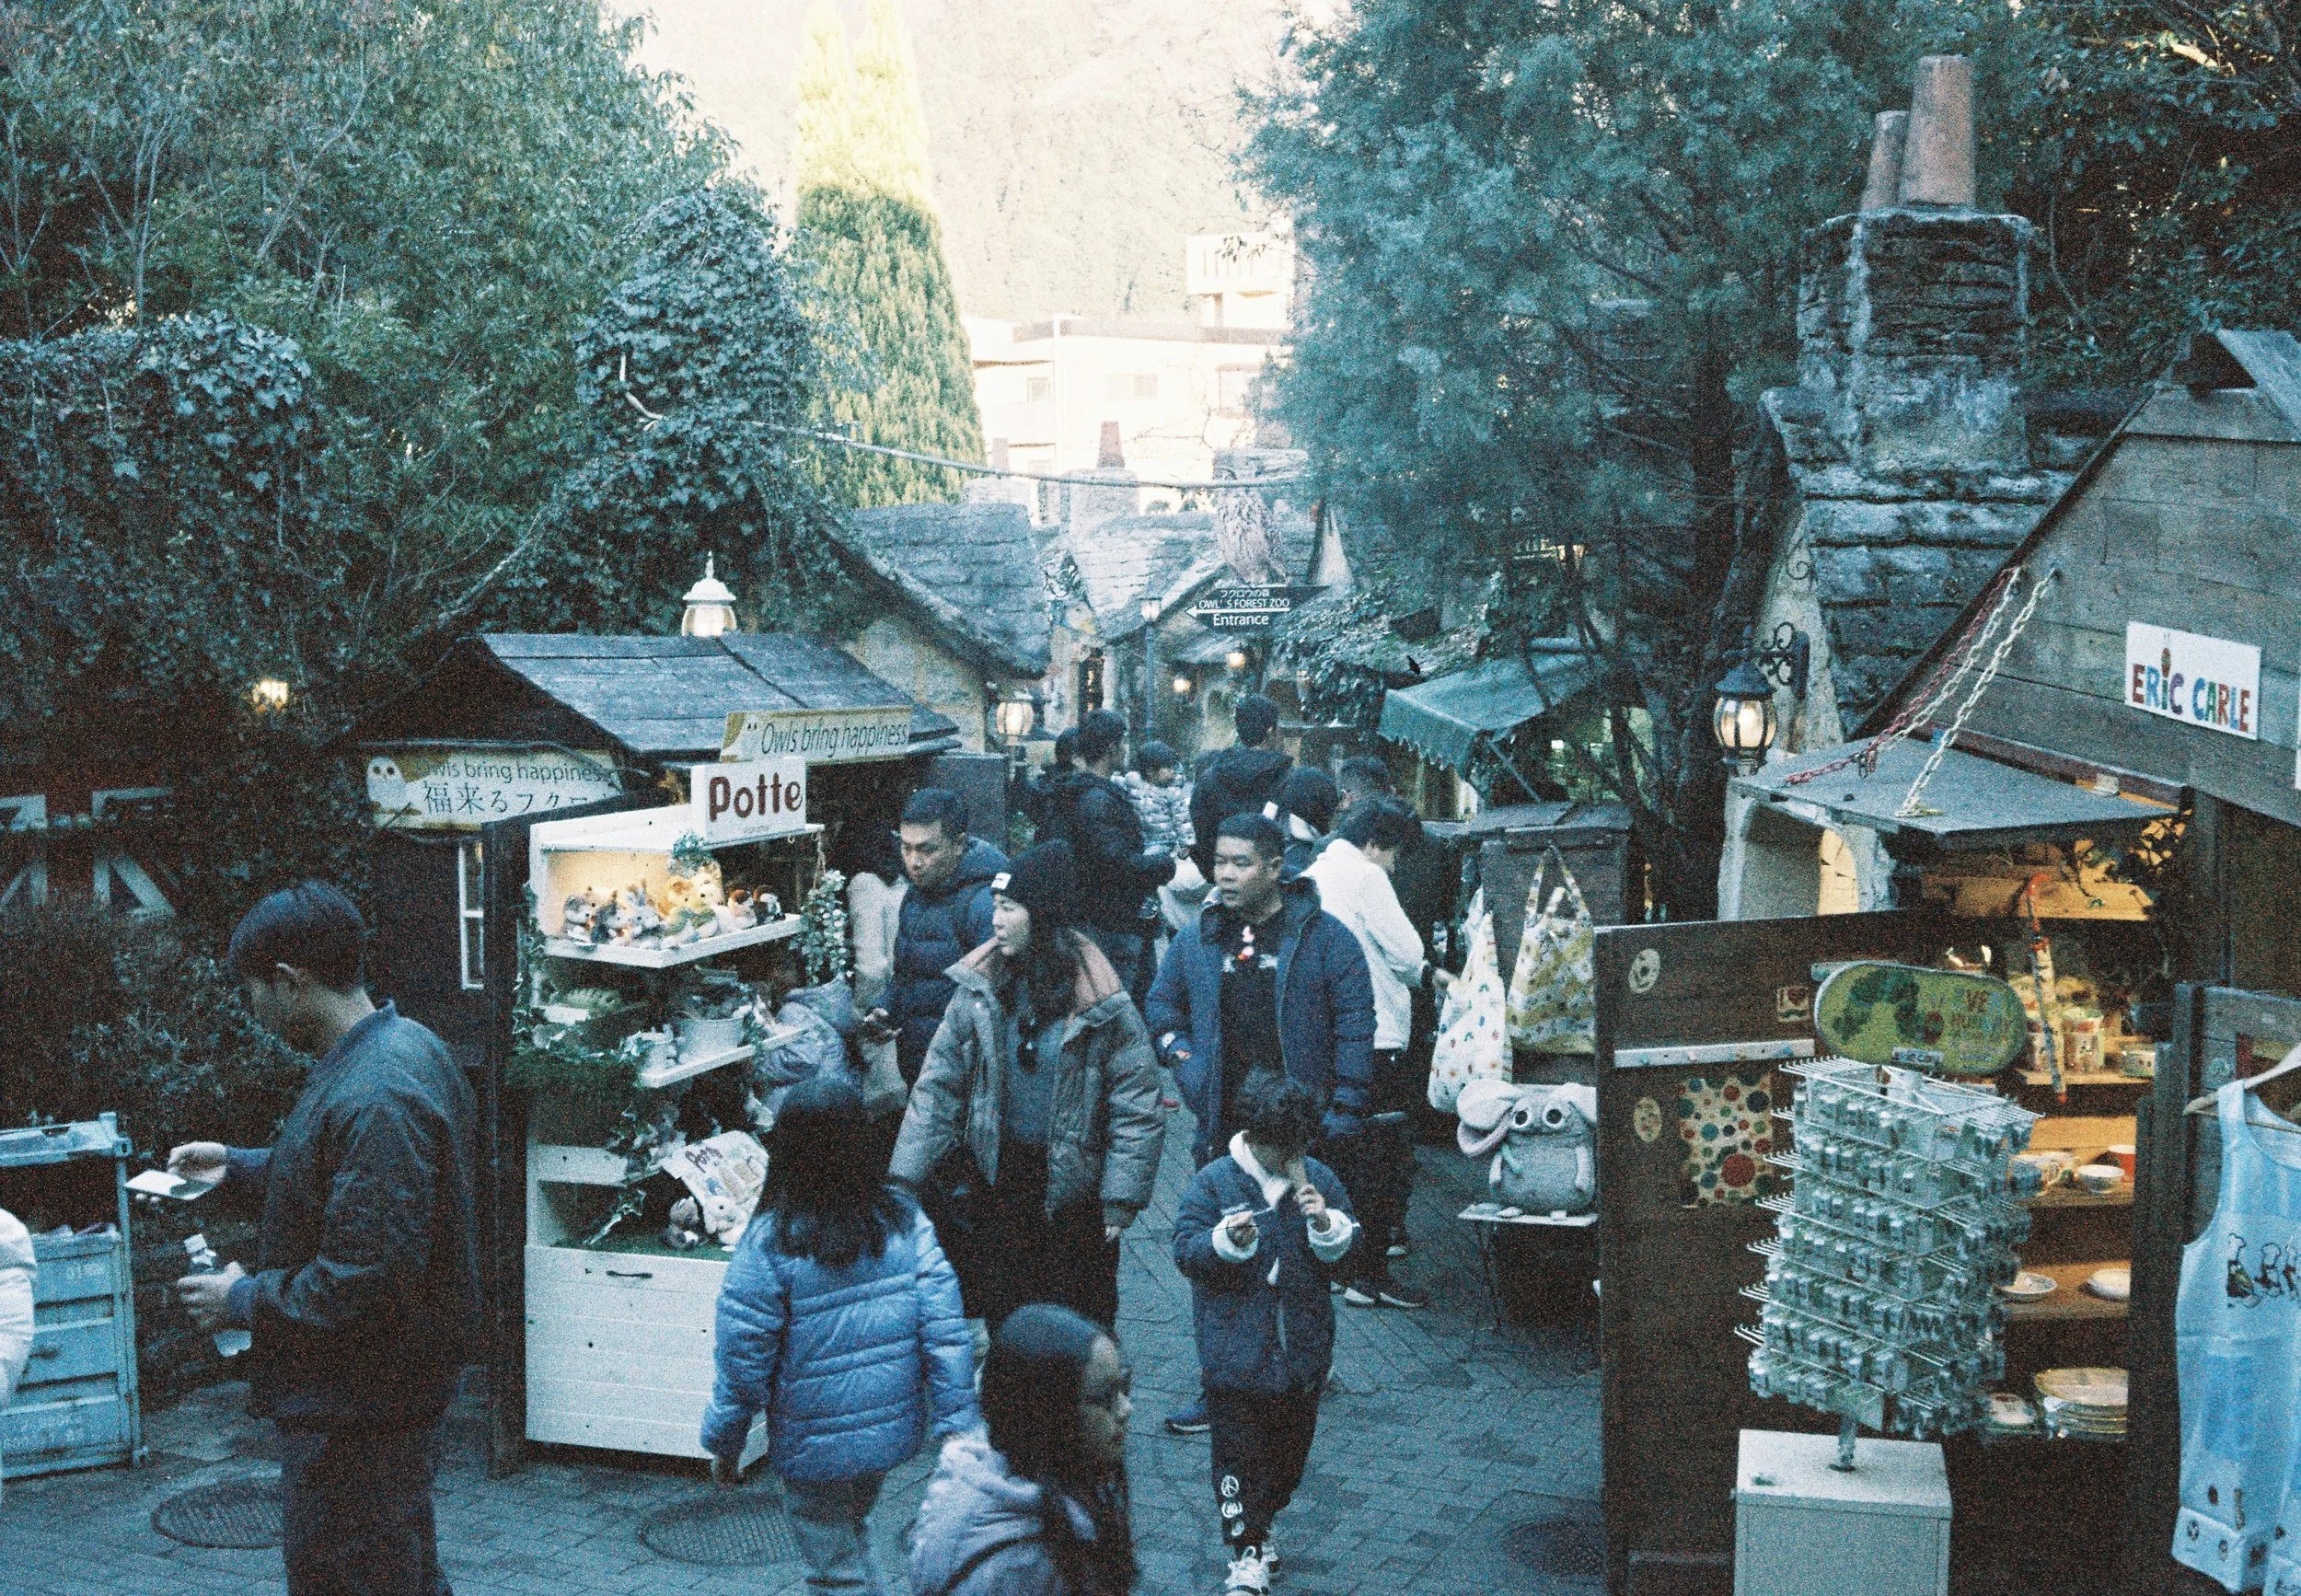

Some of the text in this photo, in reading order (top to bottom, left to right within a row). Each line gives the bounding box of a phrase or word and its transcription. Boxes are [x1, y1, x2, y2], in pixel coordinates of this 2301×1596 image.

[1213, 614, 1269, 626] Entrance
[1233, 598, 1266, 609] FOREST
[1269, 598, 1289, 608] ZOO
[2132, 661, 2251, 732] ERIC CARLE
[761, 718, 908, 757] Owls bring happiness
[465, 754, 513, 783] bring
[423, 780, 607, 814] 福来るフク
[708, 771, 804, 823] Potte
